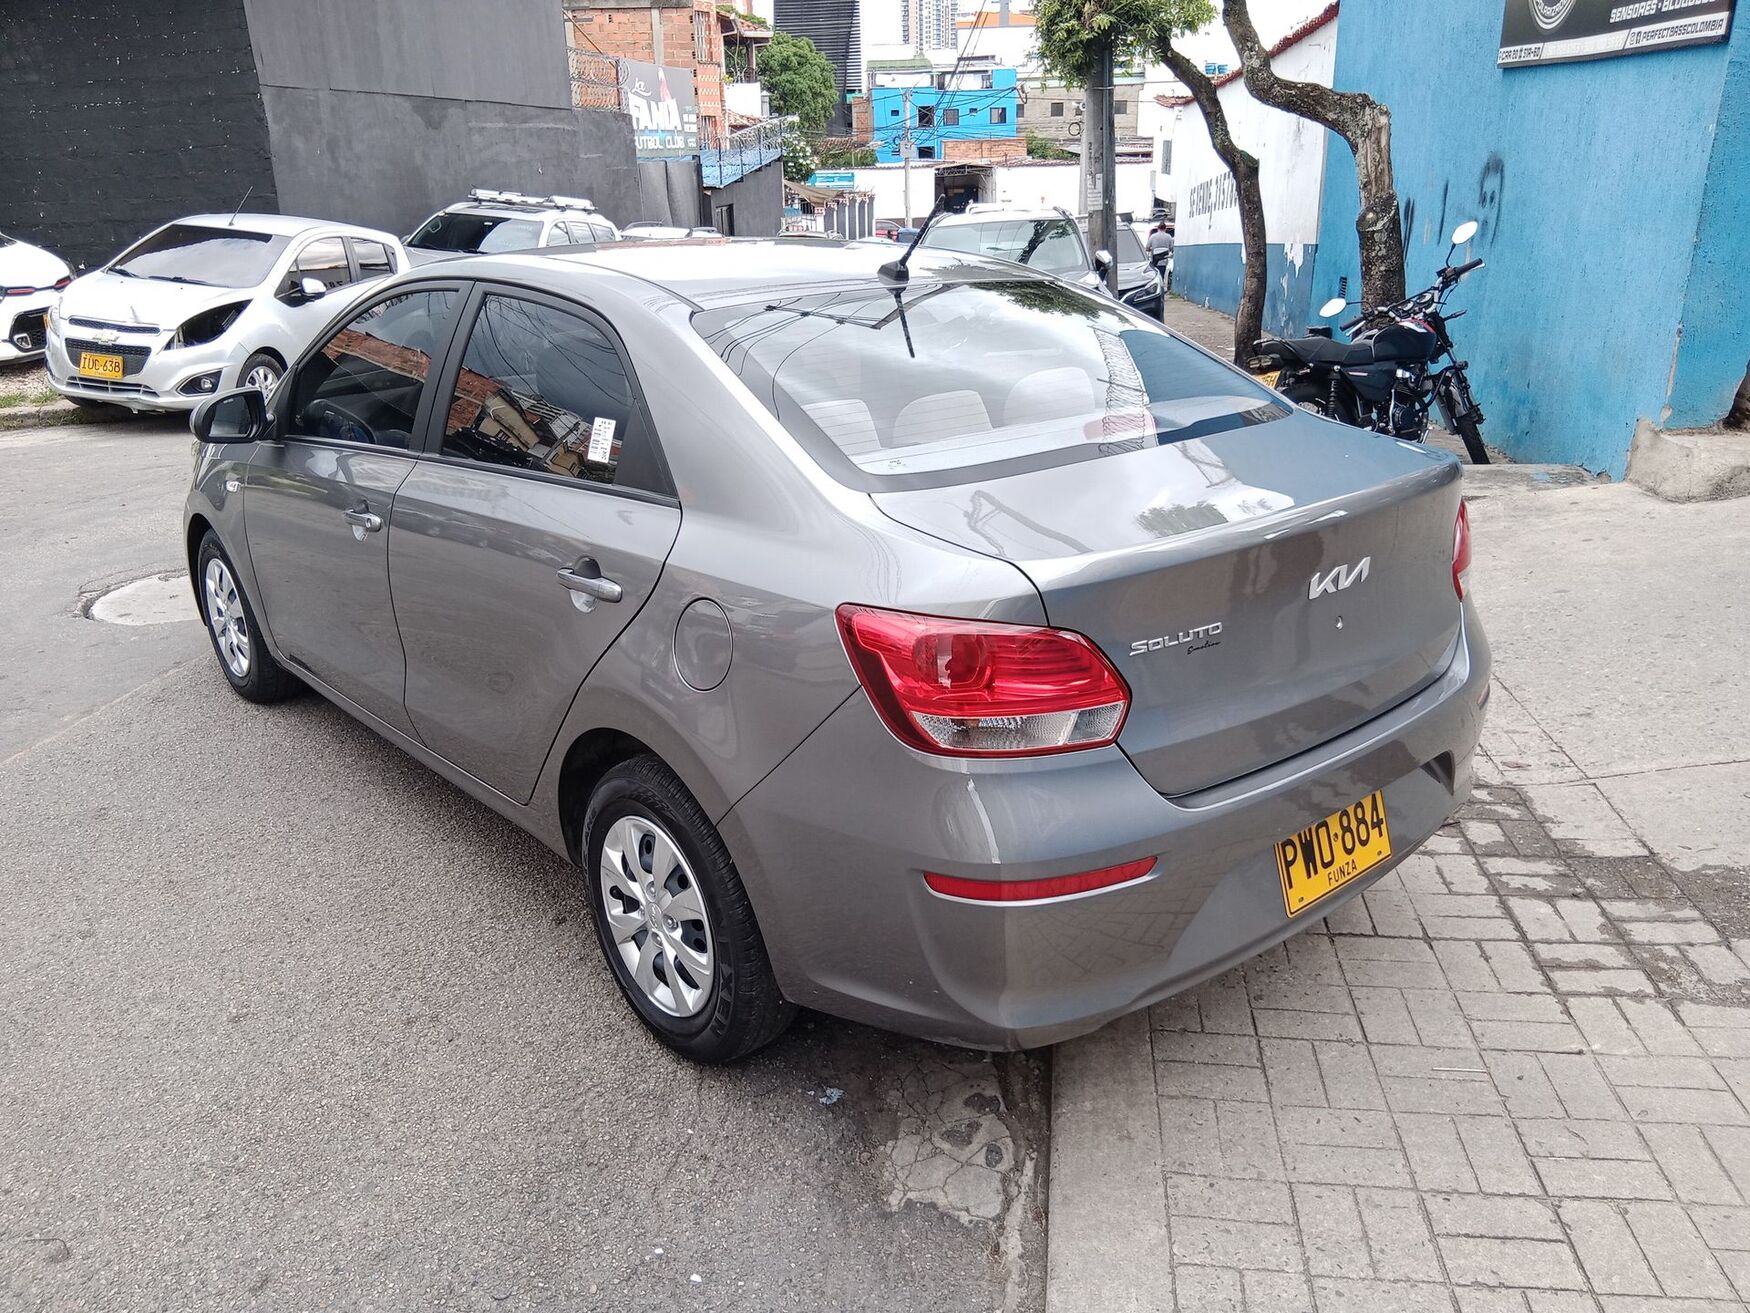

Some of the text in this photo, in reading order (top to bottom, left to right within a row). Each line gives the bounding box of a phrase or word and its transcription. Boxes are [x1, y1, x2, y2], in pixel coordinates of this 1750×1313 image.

[1609, 0, 1658, 23] SENSORES
[1642, 19, 1724, 41] PERFECTBASSCOLOMBIA
[635, 135, 663, 149] UTBOL
[665, 135, 685, 149] CLUB
[1308, 556, 1371, 600] KIA
[1129, 622, 1223, 656] SOLUTO
[1327, 859, 1358, 886] FUNZA
